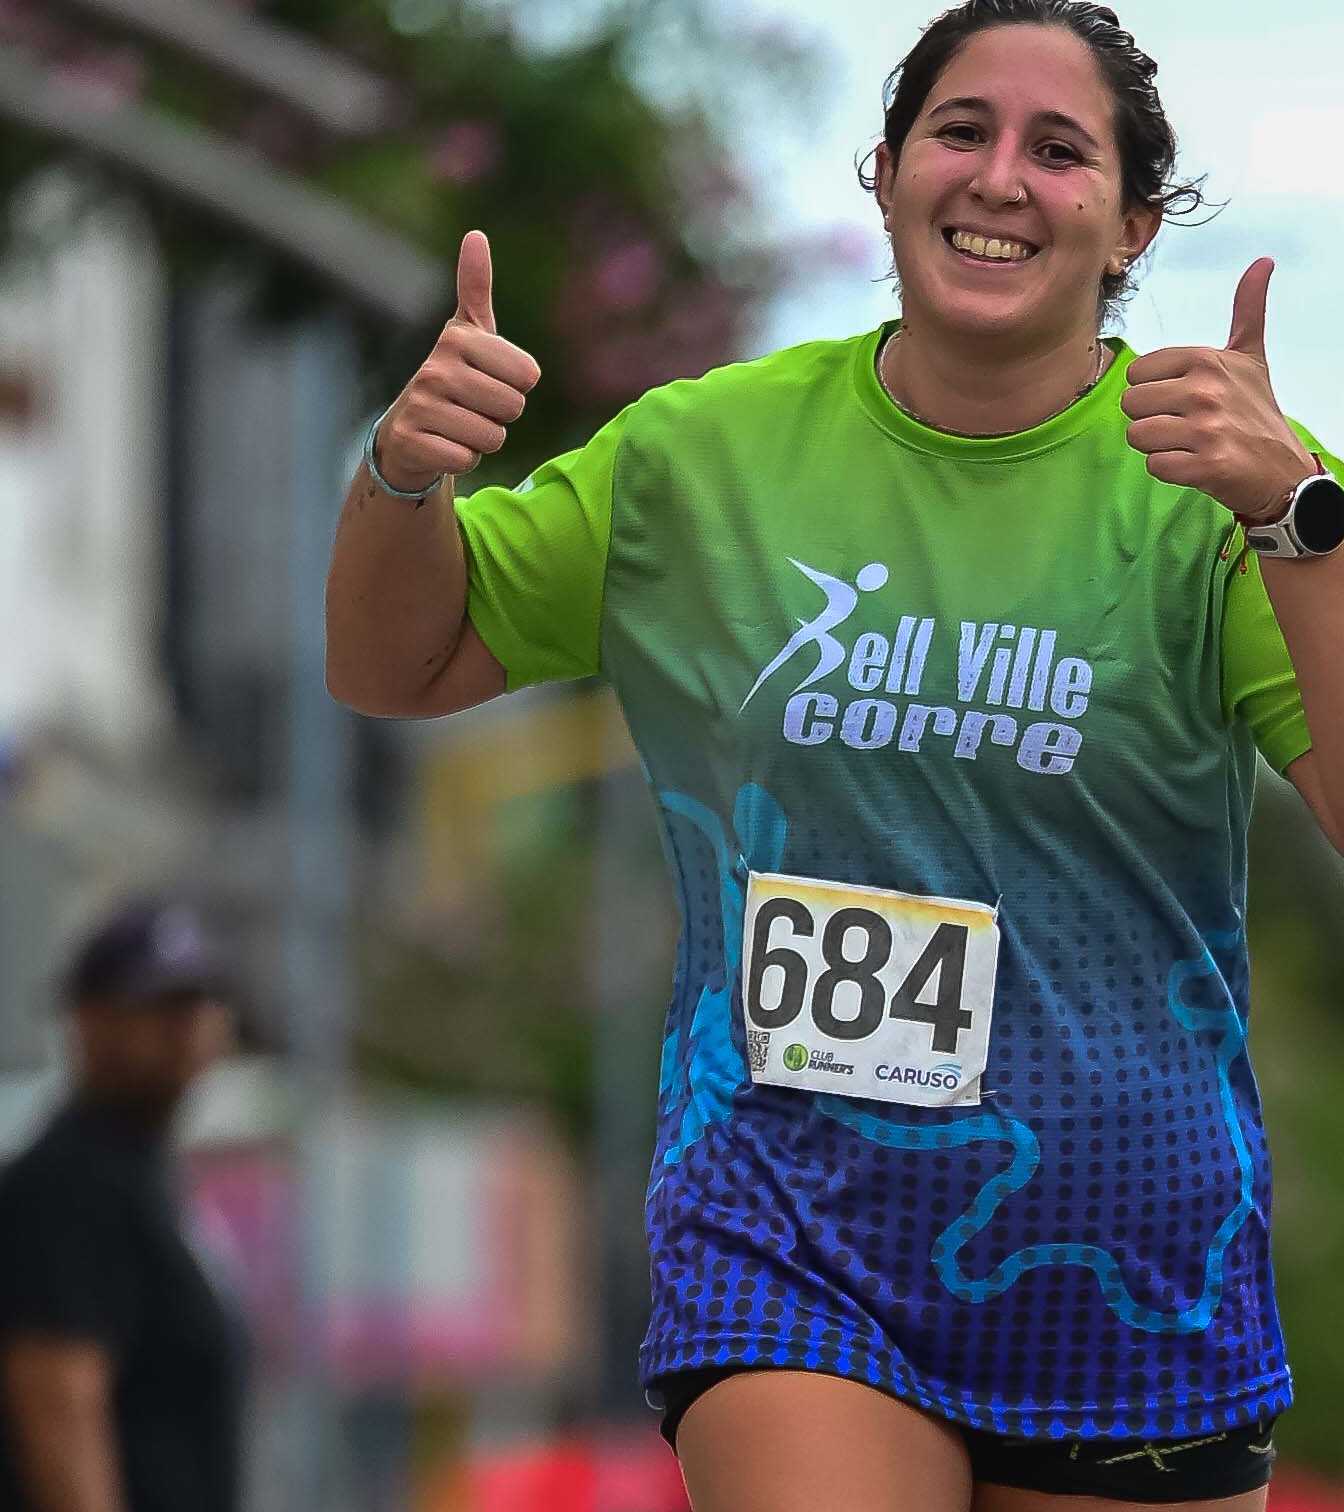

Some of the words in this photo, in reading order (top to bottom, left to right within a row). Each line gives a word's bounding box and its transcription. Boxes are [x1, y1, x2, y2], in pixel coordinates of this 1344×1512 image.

[956, 620, 1093, 719] Ville
[746, 898, 972, 1054] 684
[810, 1049, 834, 1061] CLUB
[875, 1064, 958, 1090] CARUSO
